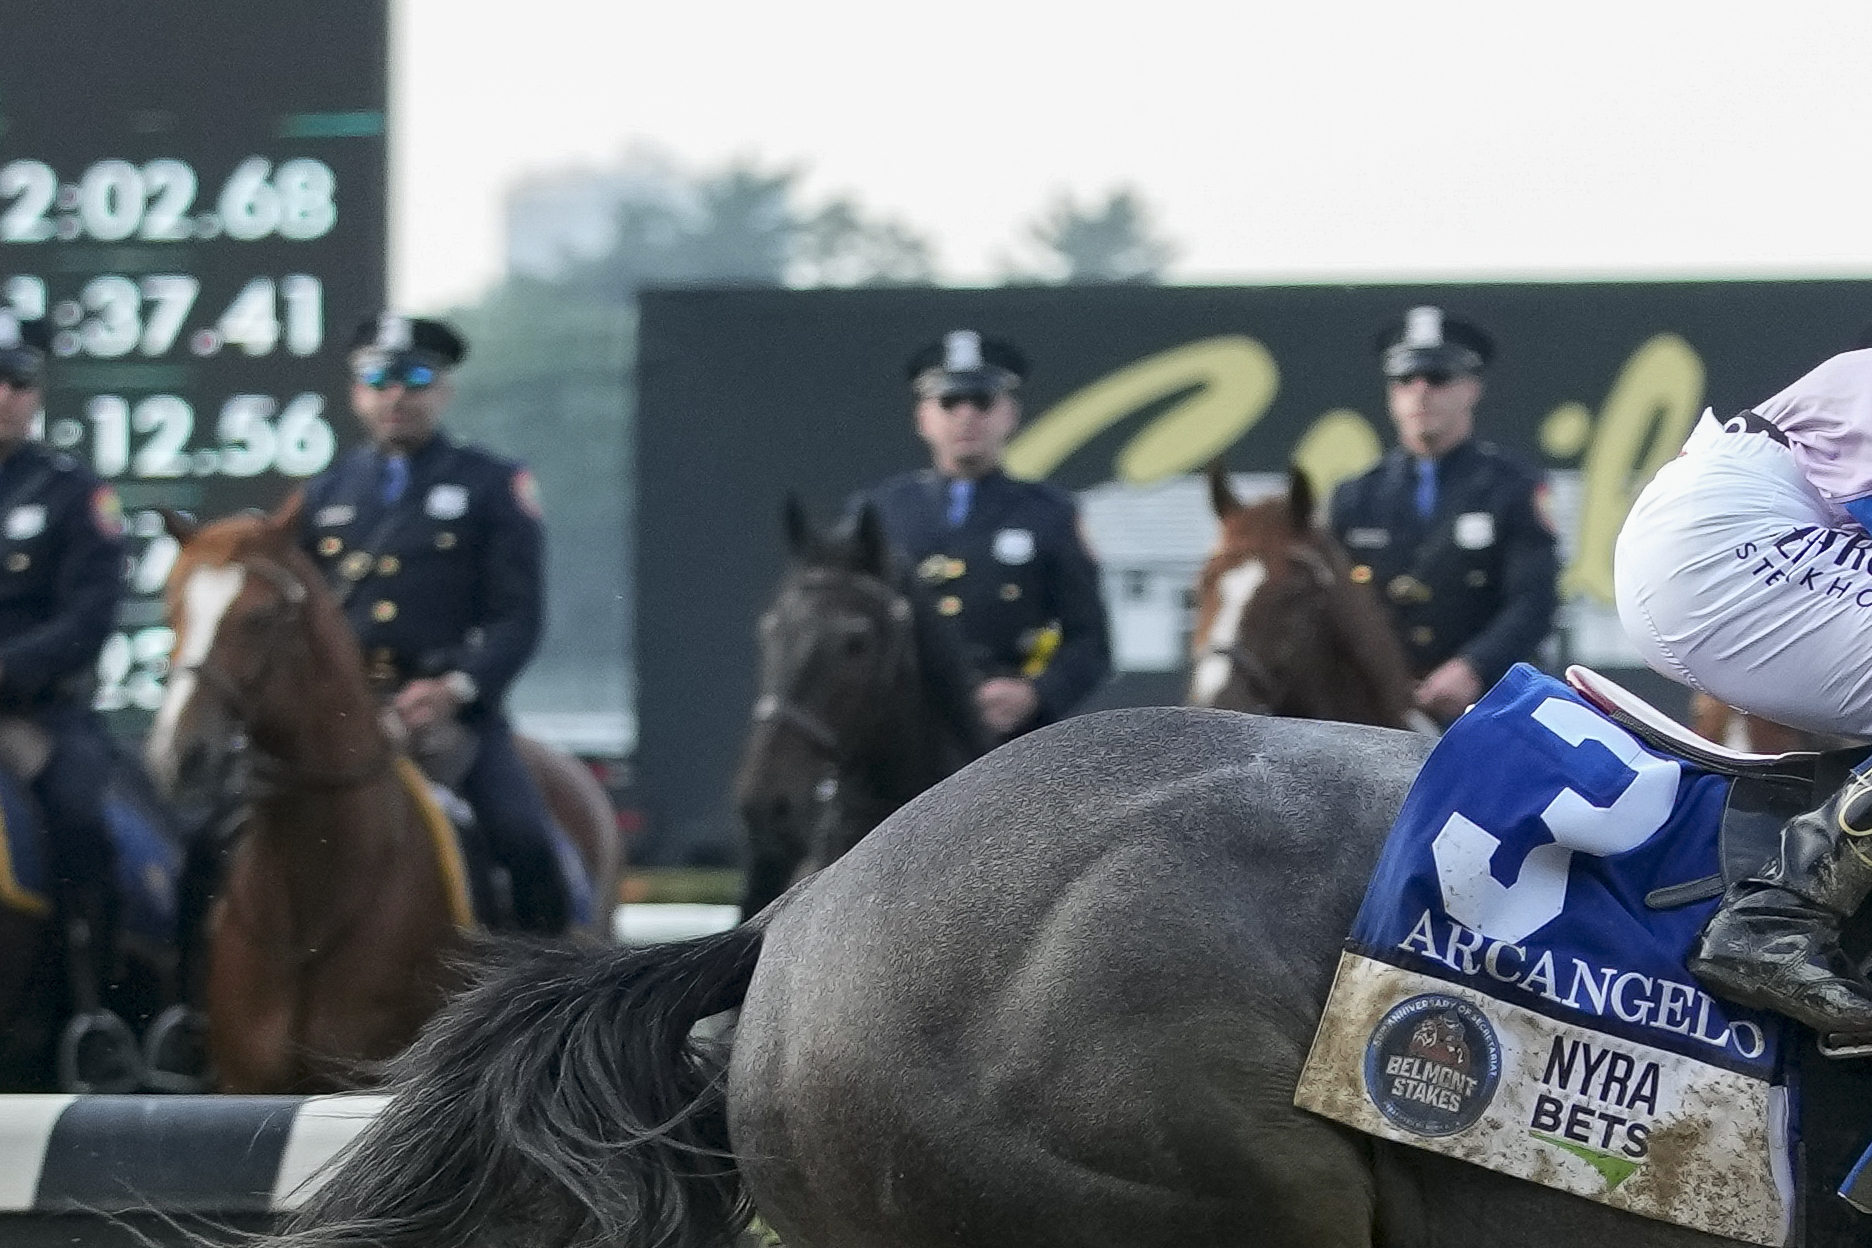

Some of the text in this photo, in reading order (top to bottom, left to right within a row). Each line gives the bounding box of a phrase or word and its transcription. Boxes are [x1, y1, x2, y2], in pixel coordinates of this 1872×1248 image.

[0, 156, 339, 241] 2:02.68
[27, 393, 339, 478] :12.56
[1432, 696, 1682, 945] 3
[1397, 908, 1766, 1059] ARCANGELO
[1385, 1054, 1479, 1098] BELMONT
[1391, 1077, 1462, 1114] STAKES
[1542, 1034, 1660, 1116] NYRA
[1530, 1093, 1652, 1158] BETS
